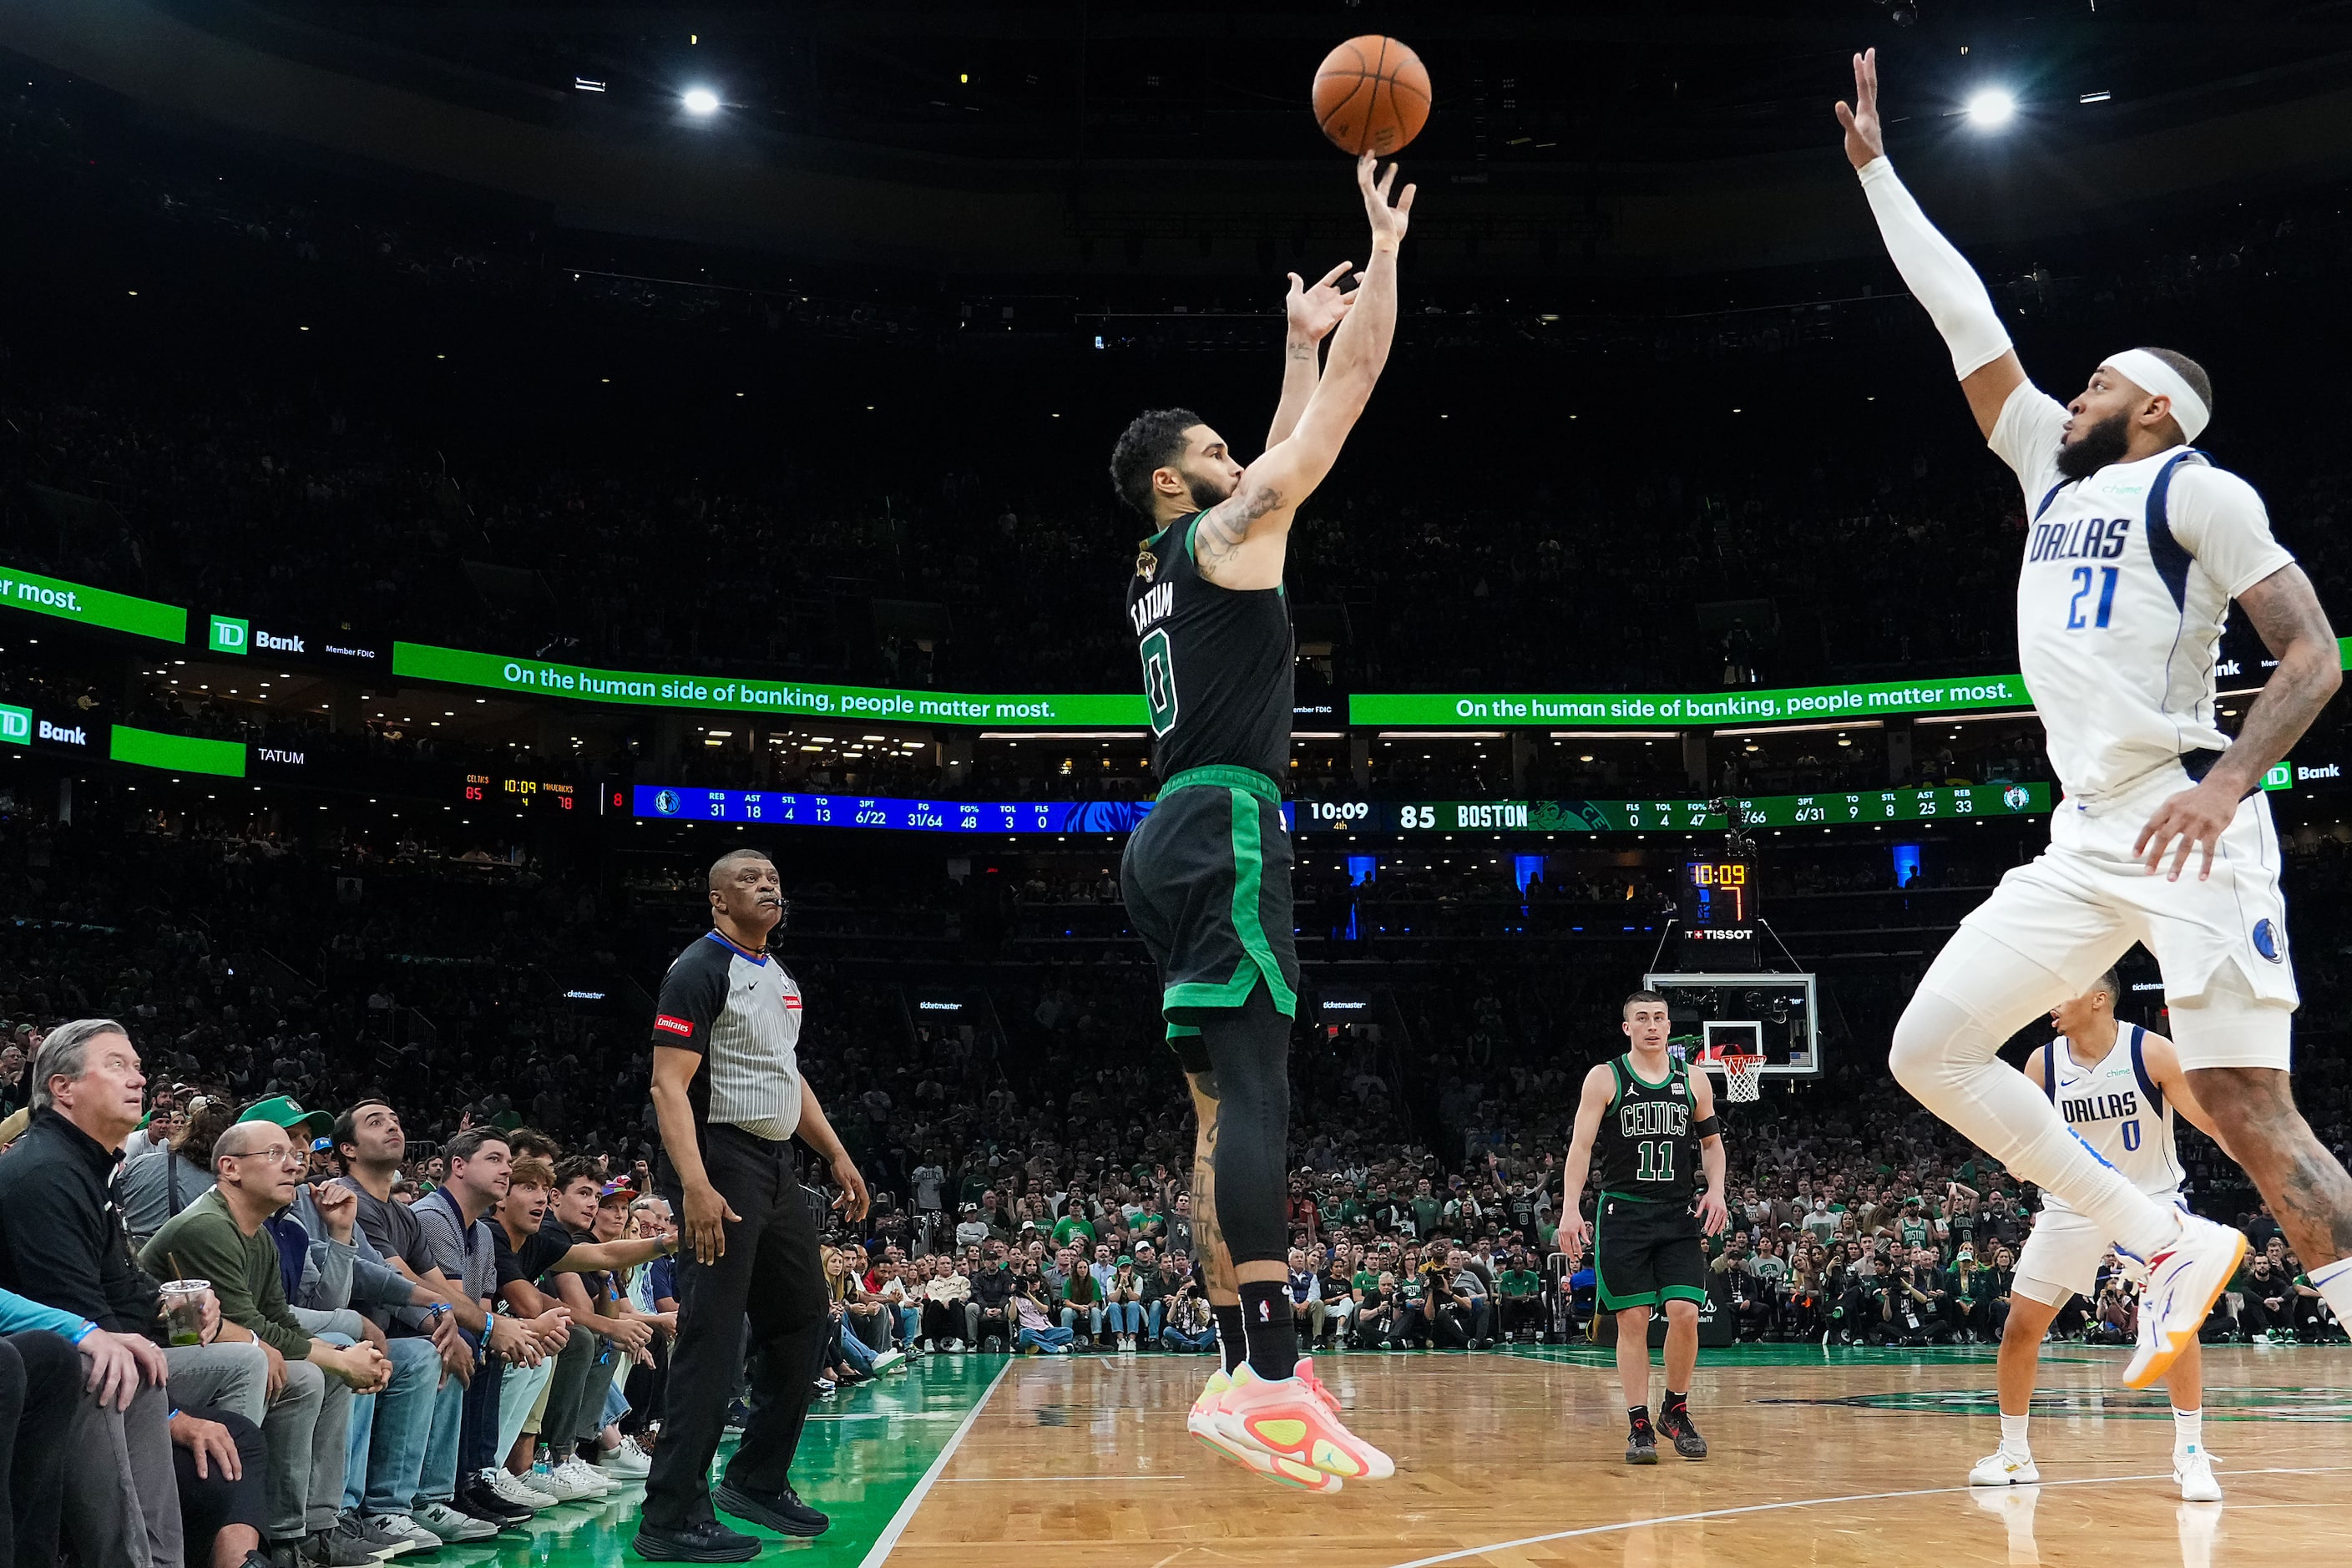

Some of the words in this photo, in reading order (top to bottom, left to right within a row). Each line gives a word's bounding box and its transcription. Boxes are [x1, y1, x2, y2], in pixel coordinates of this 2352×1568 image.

[2102, 483, 2142, 496] chime
[2030, 518, 2131, 563] DALLAS
[18, 583, 82, 612] most.
[2066, 566, 2118, 630] 21
[1130, 581, 1173, 636] TATUM
[214, 621, 244, 646] TD
[255, 630, 305, 653] Bank
[326, 645, 357, 656] Member
[357, 649, 375, 659] FDIC
[2213, 658, 2241, 678] nk
[503, 663, 534, 685] On
[539, 668, 574, 690] the
[579, 672, 655, 697] human
[661, 680, 708, 701] side
[712, 684, 736, 702] of
[741, 684, 835, 711] banking,
[841, 695, 914, 716] people
[919, 701, 991, 717] matter
[996, 701, 1055, 718] most.
[1140, 627, 1178, 738] 0
[1456, 699, 1487, 717] On
[1491, 699, 1527, 717] the
[1532, 699, 1606, 717] human
[1611, 699, 1655, 717] side
[1659, 699, 1682, 717] of
[1686, 696, 1781, 717] banking,
[1787, 690, 1863, 715] people
[1868, 688, 1945, 706] matter
[1950, 682, 2013, 701] most.
[38, 720, 86, 746] Bank
[258, 748, 304, 765] TATUM
[467, 774, 489, 784] CELTICS
[2297, 762, 2341, 781] Bank
[465, 787, 483, 801] 85
[504, 779, 536, 794] 10:09
[522, 797, 529, 807] 4
[557, 795, 574, 811] 78
[612, 792, 623, 807] 8
[709, 792, 726, 801] REB
[744, 794, 761, 802] AST
[781, 796, 796, 804] STL
[816, 797, 828, 806] TO
[859, 800, 875, 808] 3PT
[918, 802, 930, 811] FG
[959, 805, 979, 813] FG%
[999, 805, 1017, 813] TOL
[1034, 805, 1049, 813] FLS
[1626, 803, 1640, 812] FLS
[1655, 803, 1672, 812] TOL
[1687, 802, 1707, 812] FG%
[1797, 797, 1813, 806] 3PT
[1845, 795, 1859, 803] TO
[1881, 793, 1896, 802] STL
[1916, 791, 1934, 799] AST
[1954, 789, 1971, 797] REB
[711, 803, 725, 817] 31
[746, 805, 761, 818] 18
[784, 807, 794, 820] 4
[816, 808, 831, 822] 13
[855, 811, 886, 825] 6/22
[908, 813, 943, 827] 31/64
[960, 816, 977, 829] 48
[1005, 816, 1014, 829] 3
[1038, 816, 1047, 829] 0
[1311, 802, 1368, 820] 10:09
[1400, 805, 1436, 829] 85
[1456, 804, 1530, 829] BOSTON
[1630, 814, 1639, 827] 0
[1660, 814, 1670, 827] 4
[1689, 813, 1707, 827] 47
[1794, 807, 1824, 822] 6/31
[1849, 806, 1859, 819] 9
[1885, 804, 1894, 817] 8
[1919, 802, 1936, 816] 25
[1955, 800, 1973, 813] 33
[1333, 820, 1348, 830] 4th
[1695, 865, 1745, 885] 10:09
[1703, 929, 1753, 940] TISSOT
[2132, 983, 2166, 991] ticketmas
[919, 1001, 962, 1010] ticketmaster
[1323, 1001, 1366, 1009] ticketmaster
[657, 1017, 689, 1033] Emirates
[2106, 1068, 2131, 1079] chime
[2061, 1090, 2137, 1124] DALLAS
[1620, 1101, 1689, 1137] CELTICS
[2122, 1120, 2141, 1151] 0
[1636, 1141, 1675, 1181] 11
